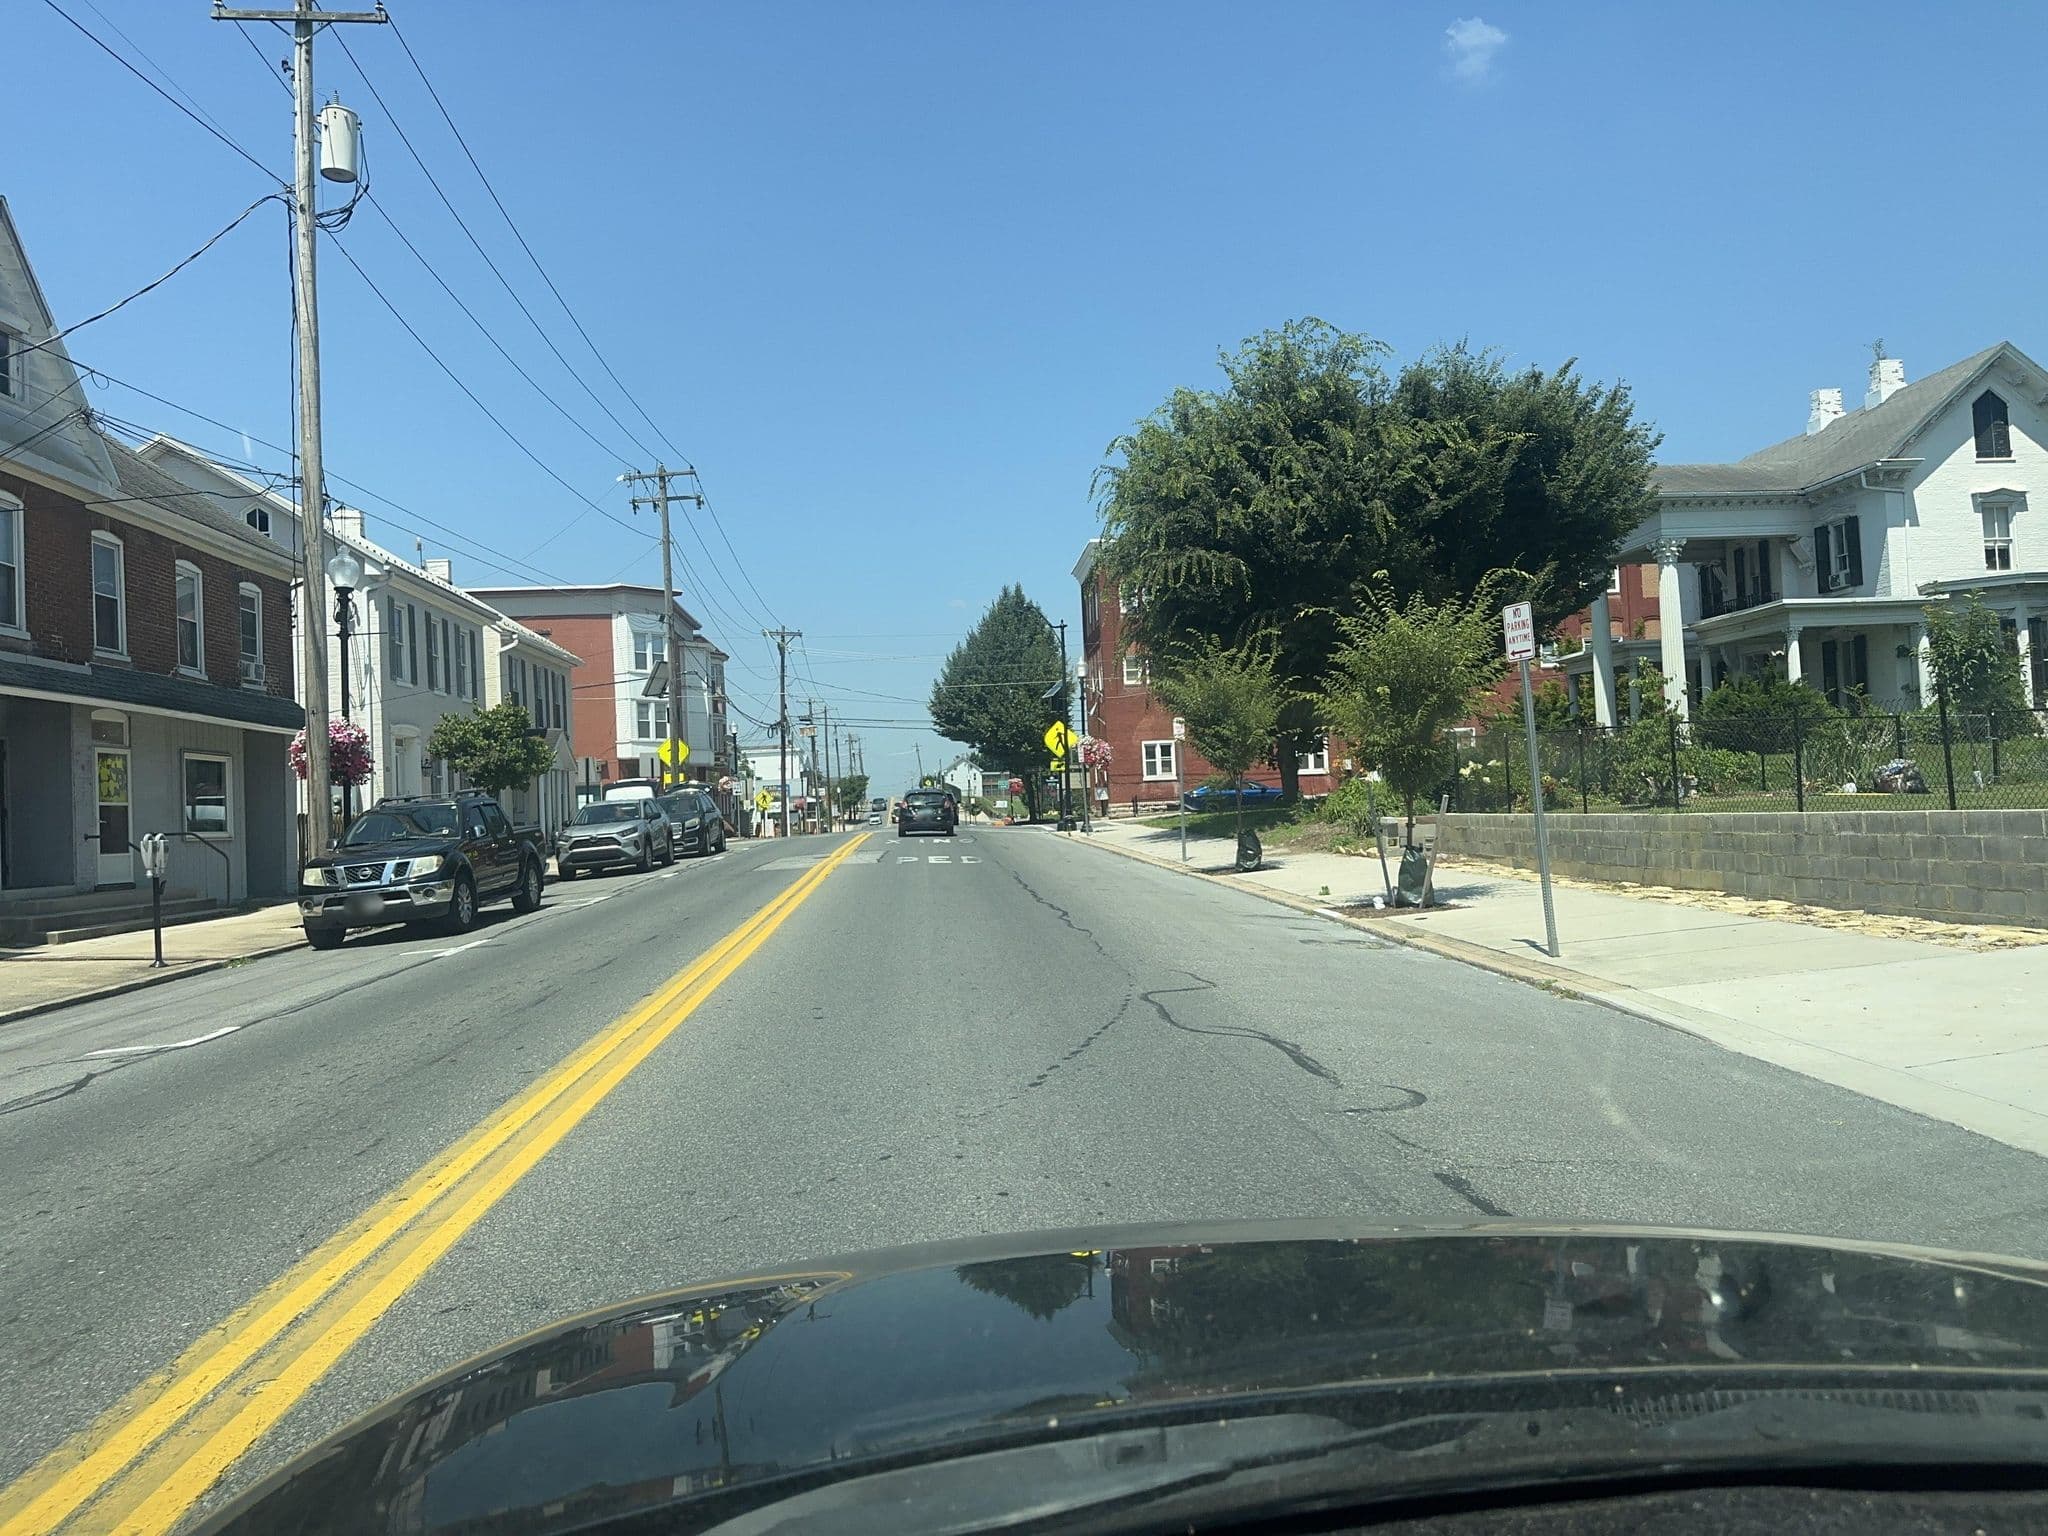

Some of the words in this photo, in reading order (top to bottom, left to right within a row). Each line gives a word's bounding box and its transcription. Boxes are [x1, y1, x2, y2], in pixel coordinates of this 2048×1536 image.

[1512, 607, 1522, 618] NO
[1507, 618, 1530, 632] PARKING
[1508, 632, 1531, 644] ANYTIME
[896, 855, 982, 864] PED
